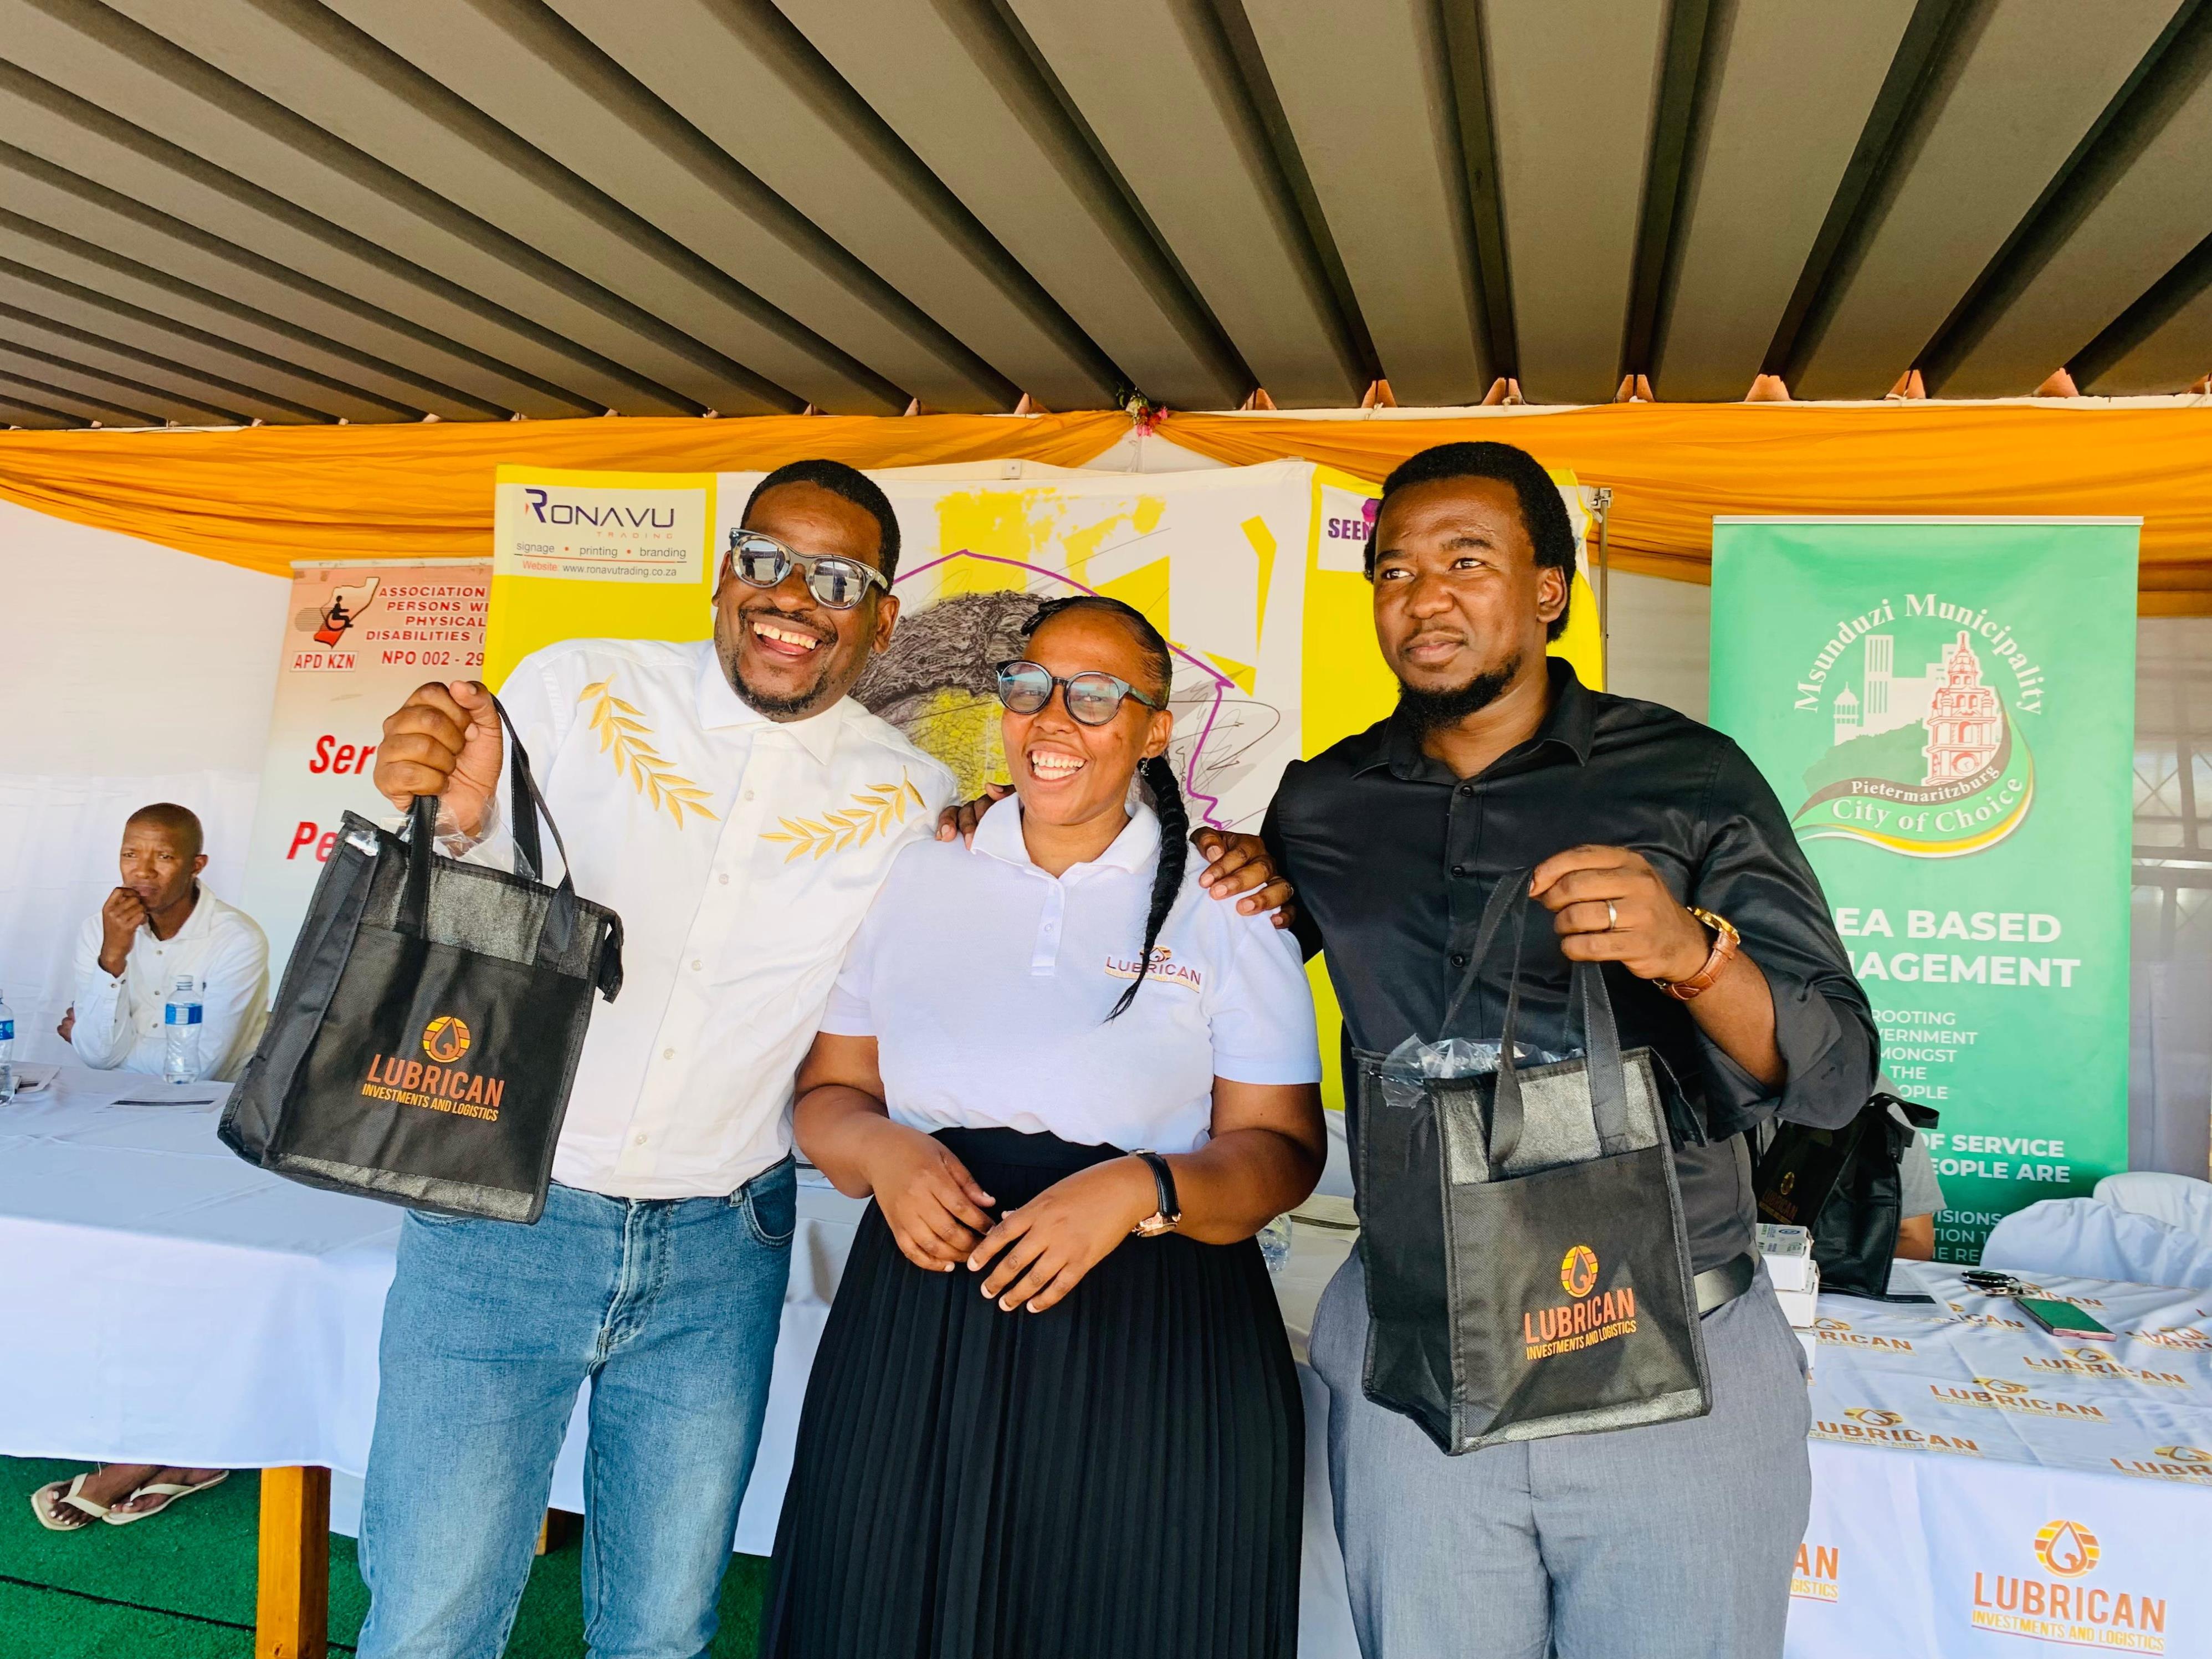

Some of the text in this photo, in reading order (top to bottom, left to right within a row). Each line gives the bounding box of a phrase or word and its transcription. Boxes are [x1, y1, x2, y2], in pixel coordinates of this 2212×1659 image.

[524, 488, 675, 528] RONAVU
[516, 541, 687, 559] signage printing branding
[562, 563, 677, 577] www.ronavutrading.co.za
[379, 587, 485, 597] ASSOCIATION
[387, 602, 461, 611] PERSONS
[406, 617, 486, 627] PHYSICAL
[366, 632, 470, 641] DISABILITIES
[294, 654, 355, 668] APD KZN
[382, 651, 416, 665] NPO
[422, 652, 450, 665] 002
[1794, 594, 2045, 715] Msunduzi Municipality
[309, 735, 377, 774] Ser
[1851, 765, 2000, 802] Pietermaritzburg
[1832, 777, 2022, 832] City of Choice
[1908, 910, 2061, 943] BASED
[1846, 951, 2081, 987] AGEMENT
[367, 1054, 505, 1107] LUBRICAN
[1890, 1066, 1927, 1079] THE
[362, 1083, 499, 1122] INVESTMENTS AND LOGISTICS
[1895, 1084, 1948, 1099] OPLE
[1952, 1134, 2064, 1158] SERVICE
[2016, 1164, 2071, 1183] ARE
[1932, 1210, 2003, 1226] ISIONS
[1525, 1287, 1635, 1344] LUBRICAN
[1527, 1320, 1637, 1360] INVESTMENTS AND LOGISTICS
[2022, 1356, 2186, 1383] LUBRICAN
[1929, 1385, 2104, 1417] LUBRICAN
[1810, 1421, 1979, 1451] UBRICAN
[1790, 1578, 1839, 1598] GISTICS
[1974, 1571, 2166, 1633] LUBRICAN
[1972, 1610, 2165, 1651] INVESTMENTS AND LOGISTICS
